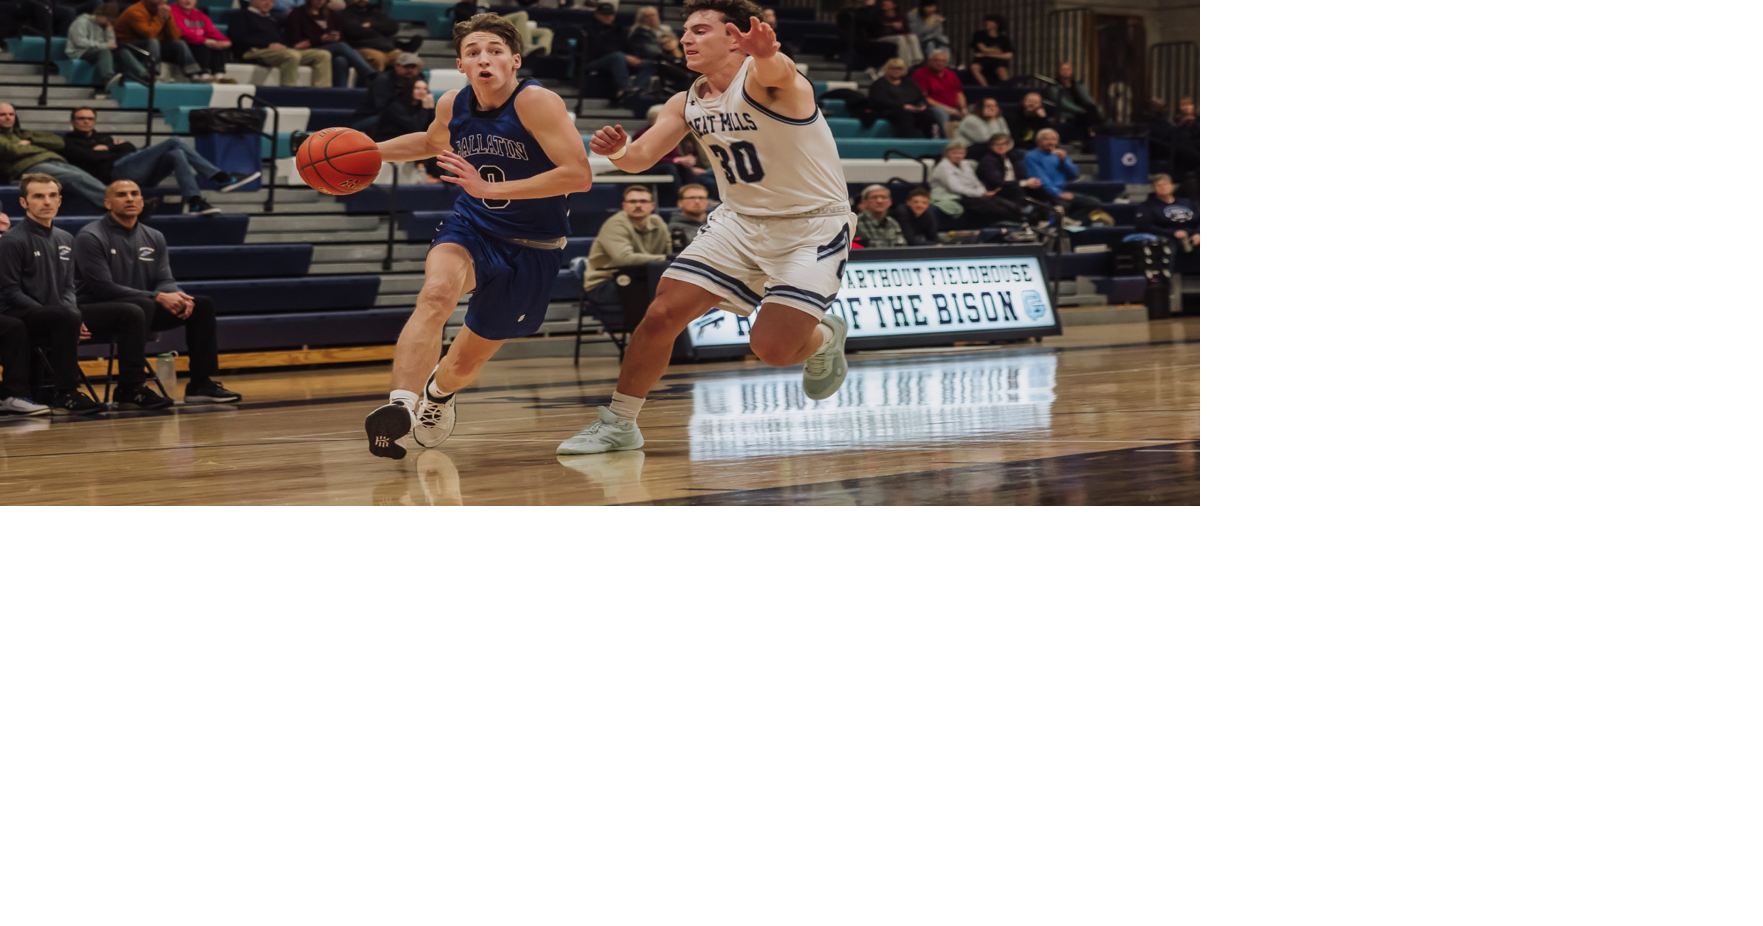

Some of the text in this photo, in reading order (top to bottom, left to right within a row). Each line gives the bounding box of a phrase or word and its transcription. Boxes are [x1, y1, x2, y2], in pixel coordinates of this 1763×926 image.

[688, 115, 715, 137] EAT
[708, 140, 766, 185] 30
[840, 268, 923, 289] ARTHOUT
[928, 264, 1033, 286] FIELDHOUSE
[830, 290, 1018, 330] OF THE BISON
